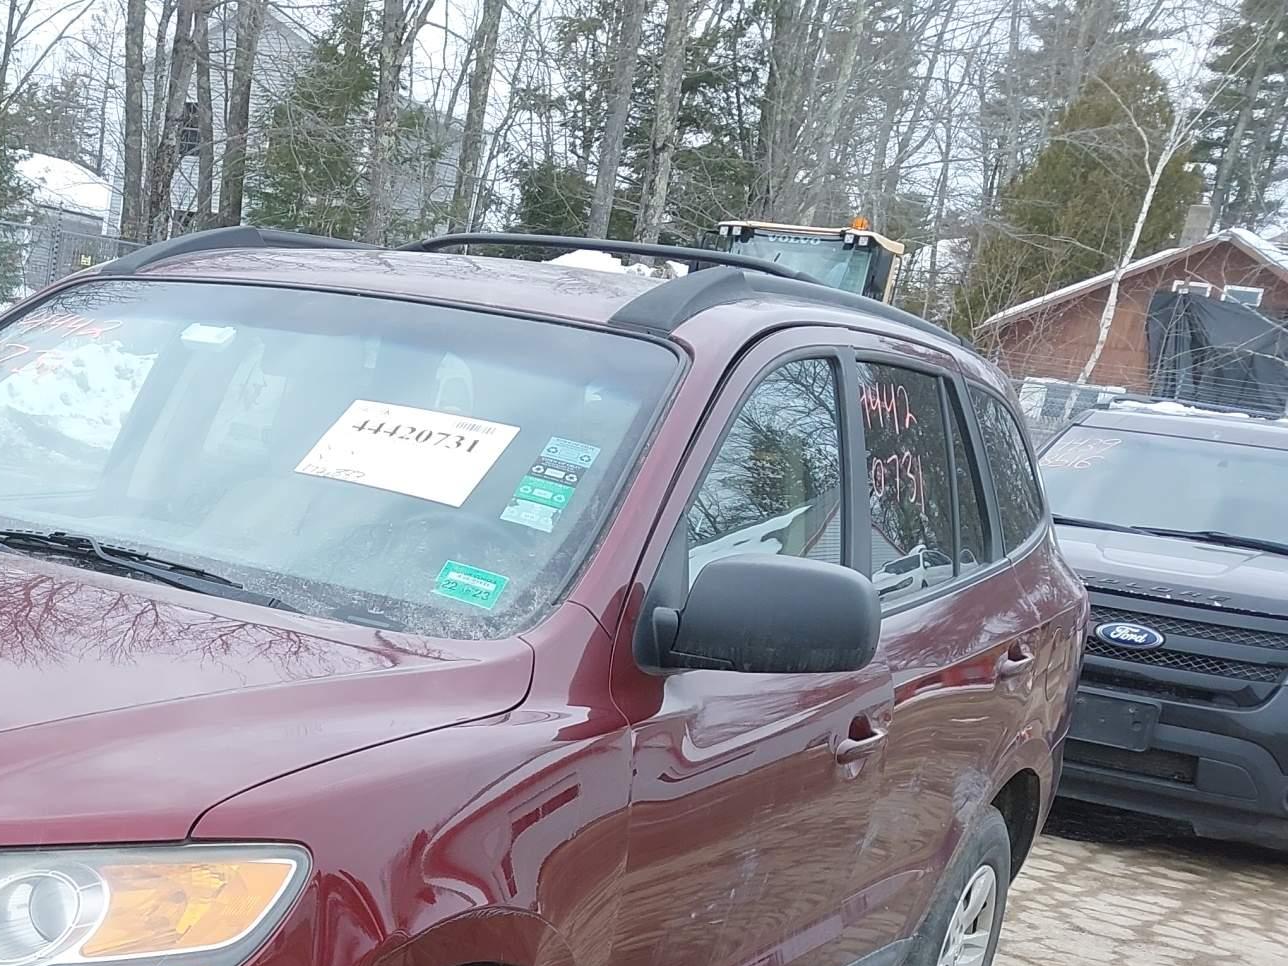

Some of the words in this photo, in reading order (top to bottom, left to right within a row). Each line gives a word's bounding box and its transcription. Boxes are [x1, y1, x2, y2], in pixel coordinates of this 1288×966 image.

[768, 233, 821, 245] VOLVO
[351, 420, 480, 453] 44420731
[872, 451, 925, 514] 0731
[1110, 626, 1148, 643] Ford
